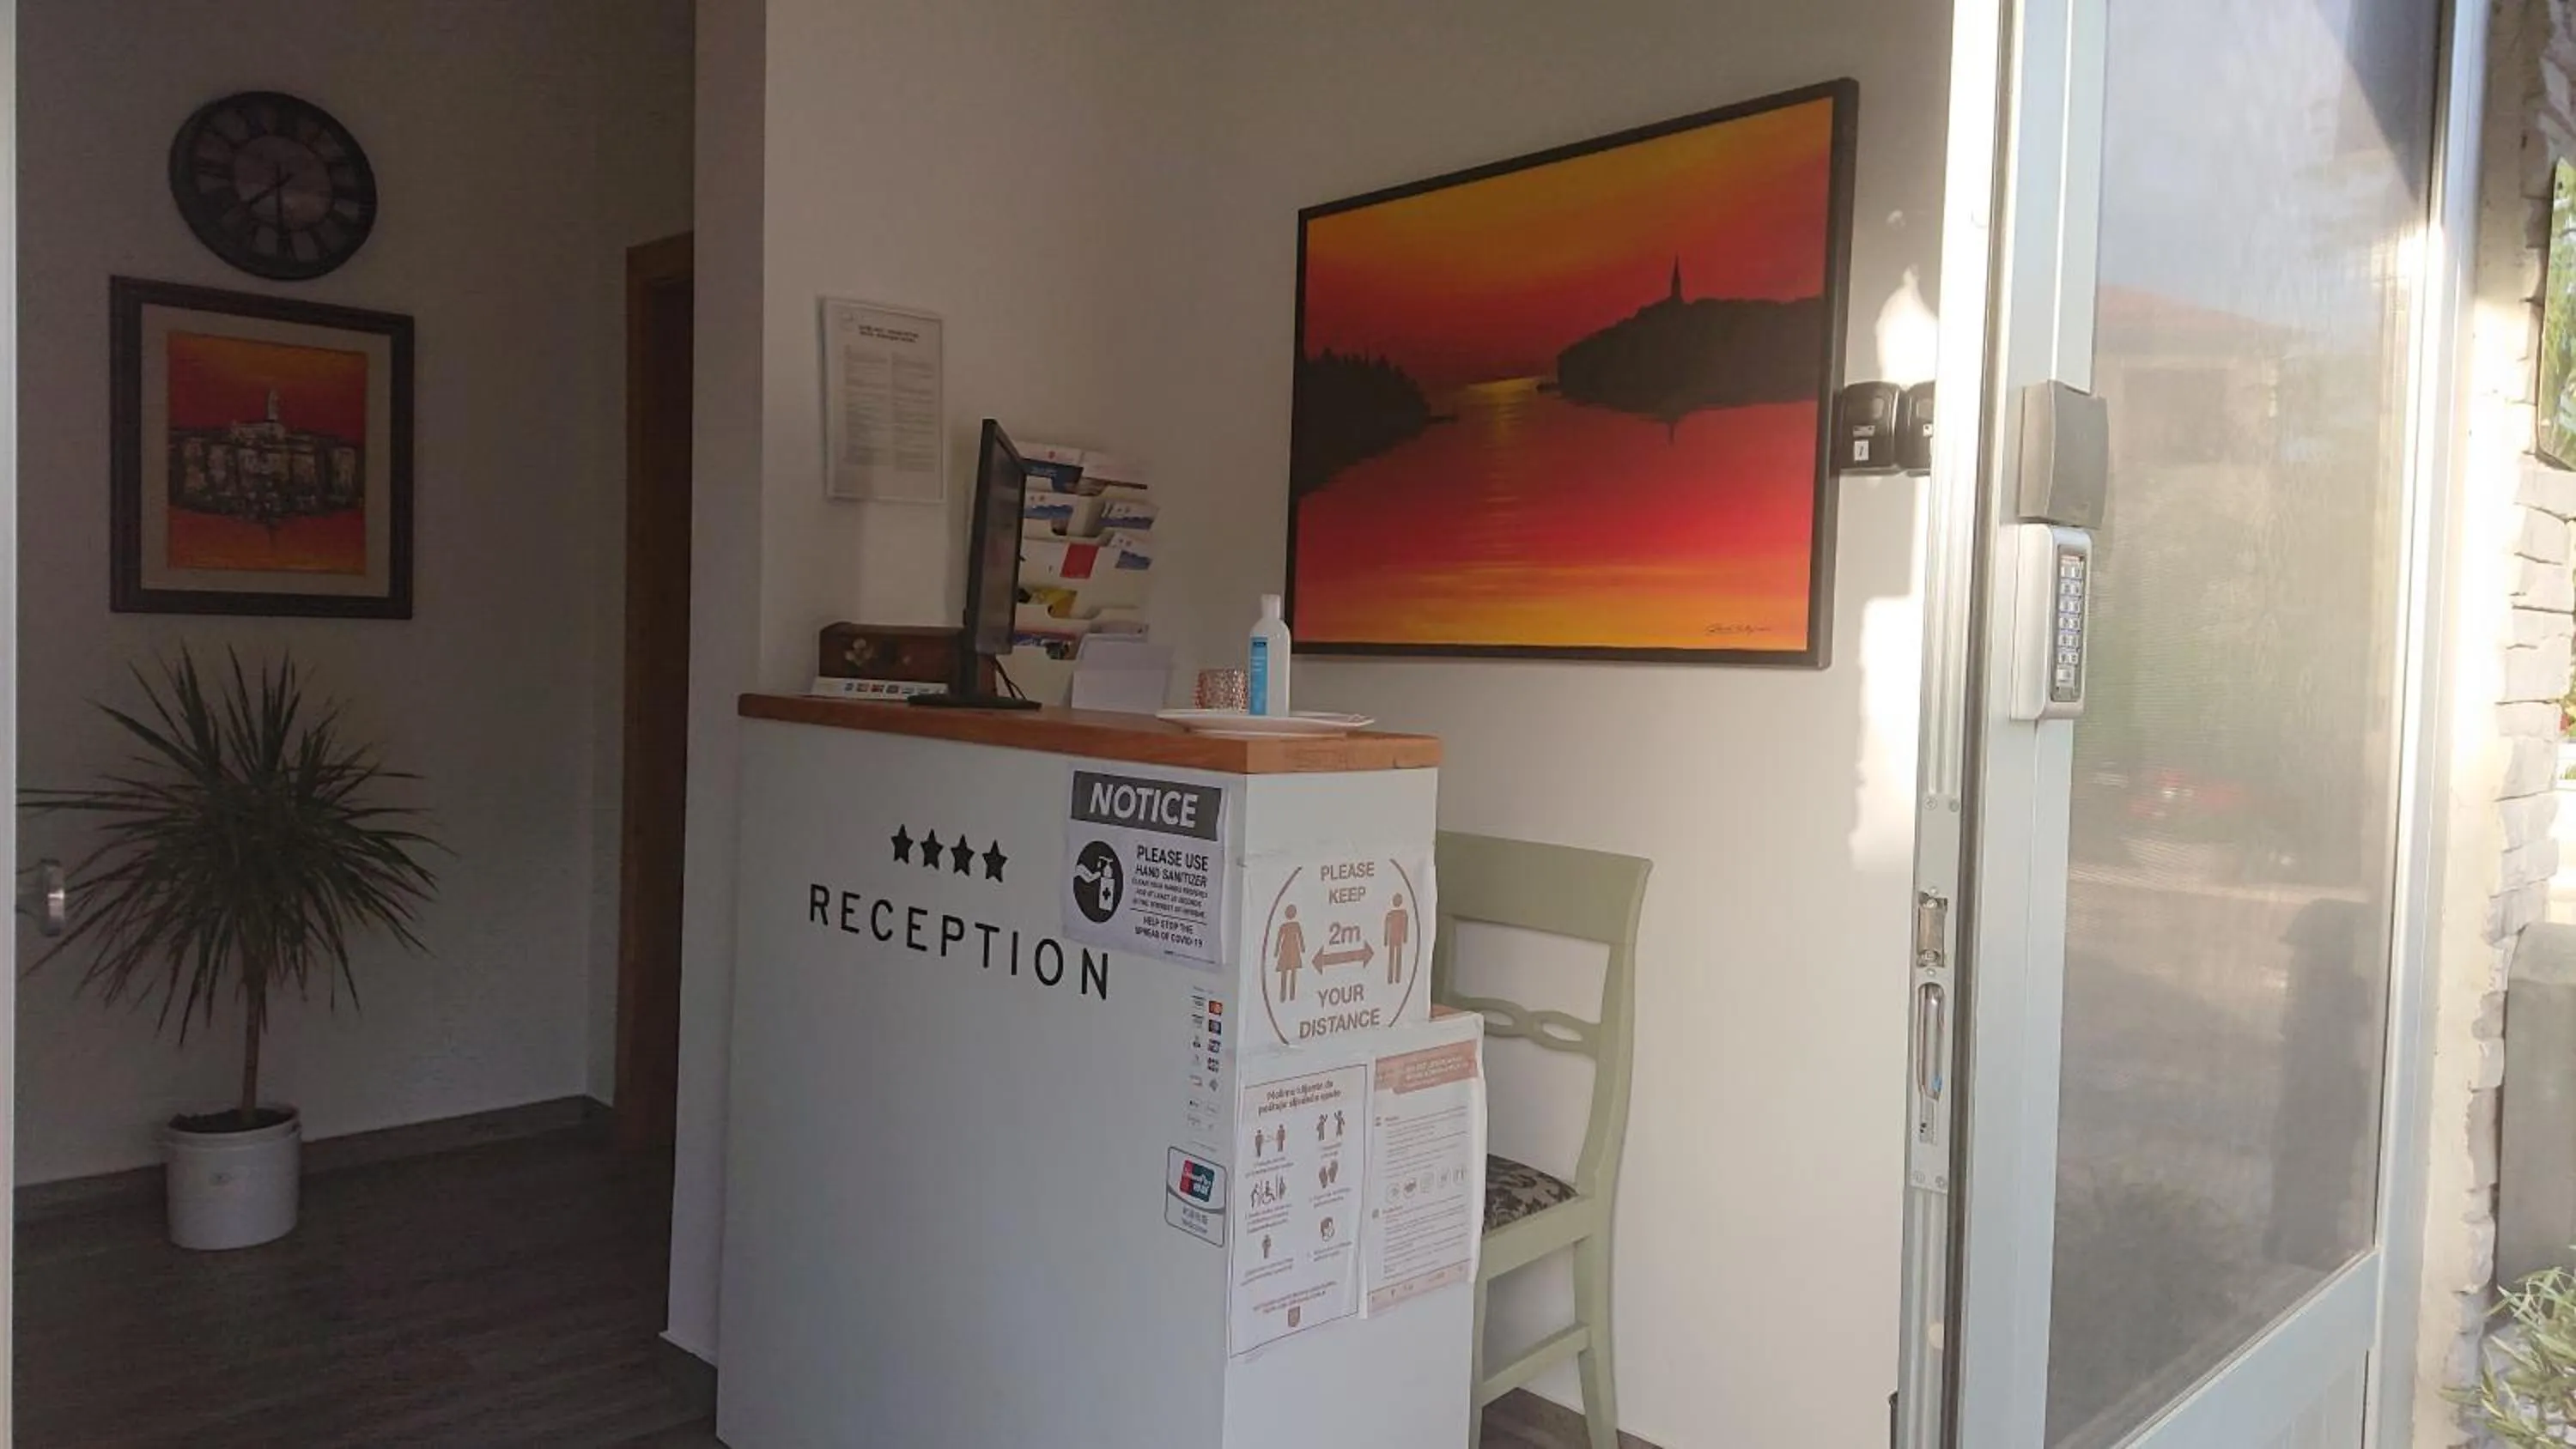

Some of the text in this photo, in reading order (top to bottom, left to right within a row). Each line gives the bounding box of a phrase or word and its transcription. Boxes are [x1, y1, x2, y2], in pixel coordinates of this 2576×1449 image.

[1089, 782, 1200, 828] NOTICE
[1137, 845, 1209, 872] PLEASE USE
[1135, 864, 1209, 888] HAND SANITIZER
[1320, 861, 1375, 882] PLEASE
[1328, 886, 1366, 904] KEEP
[1143, 915, 1160, 926] HELP
[1161, 919, 1179, 930] STOP
[1328, 921, 1361, 945] 2m
[809, 883, 1109, 1001] RECEPTION
[1318, 983, 1364, 1008] YOUR
[1299, 1008, 1381, 1040] DISTANCE
